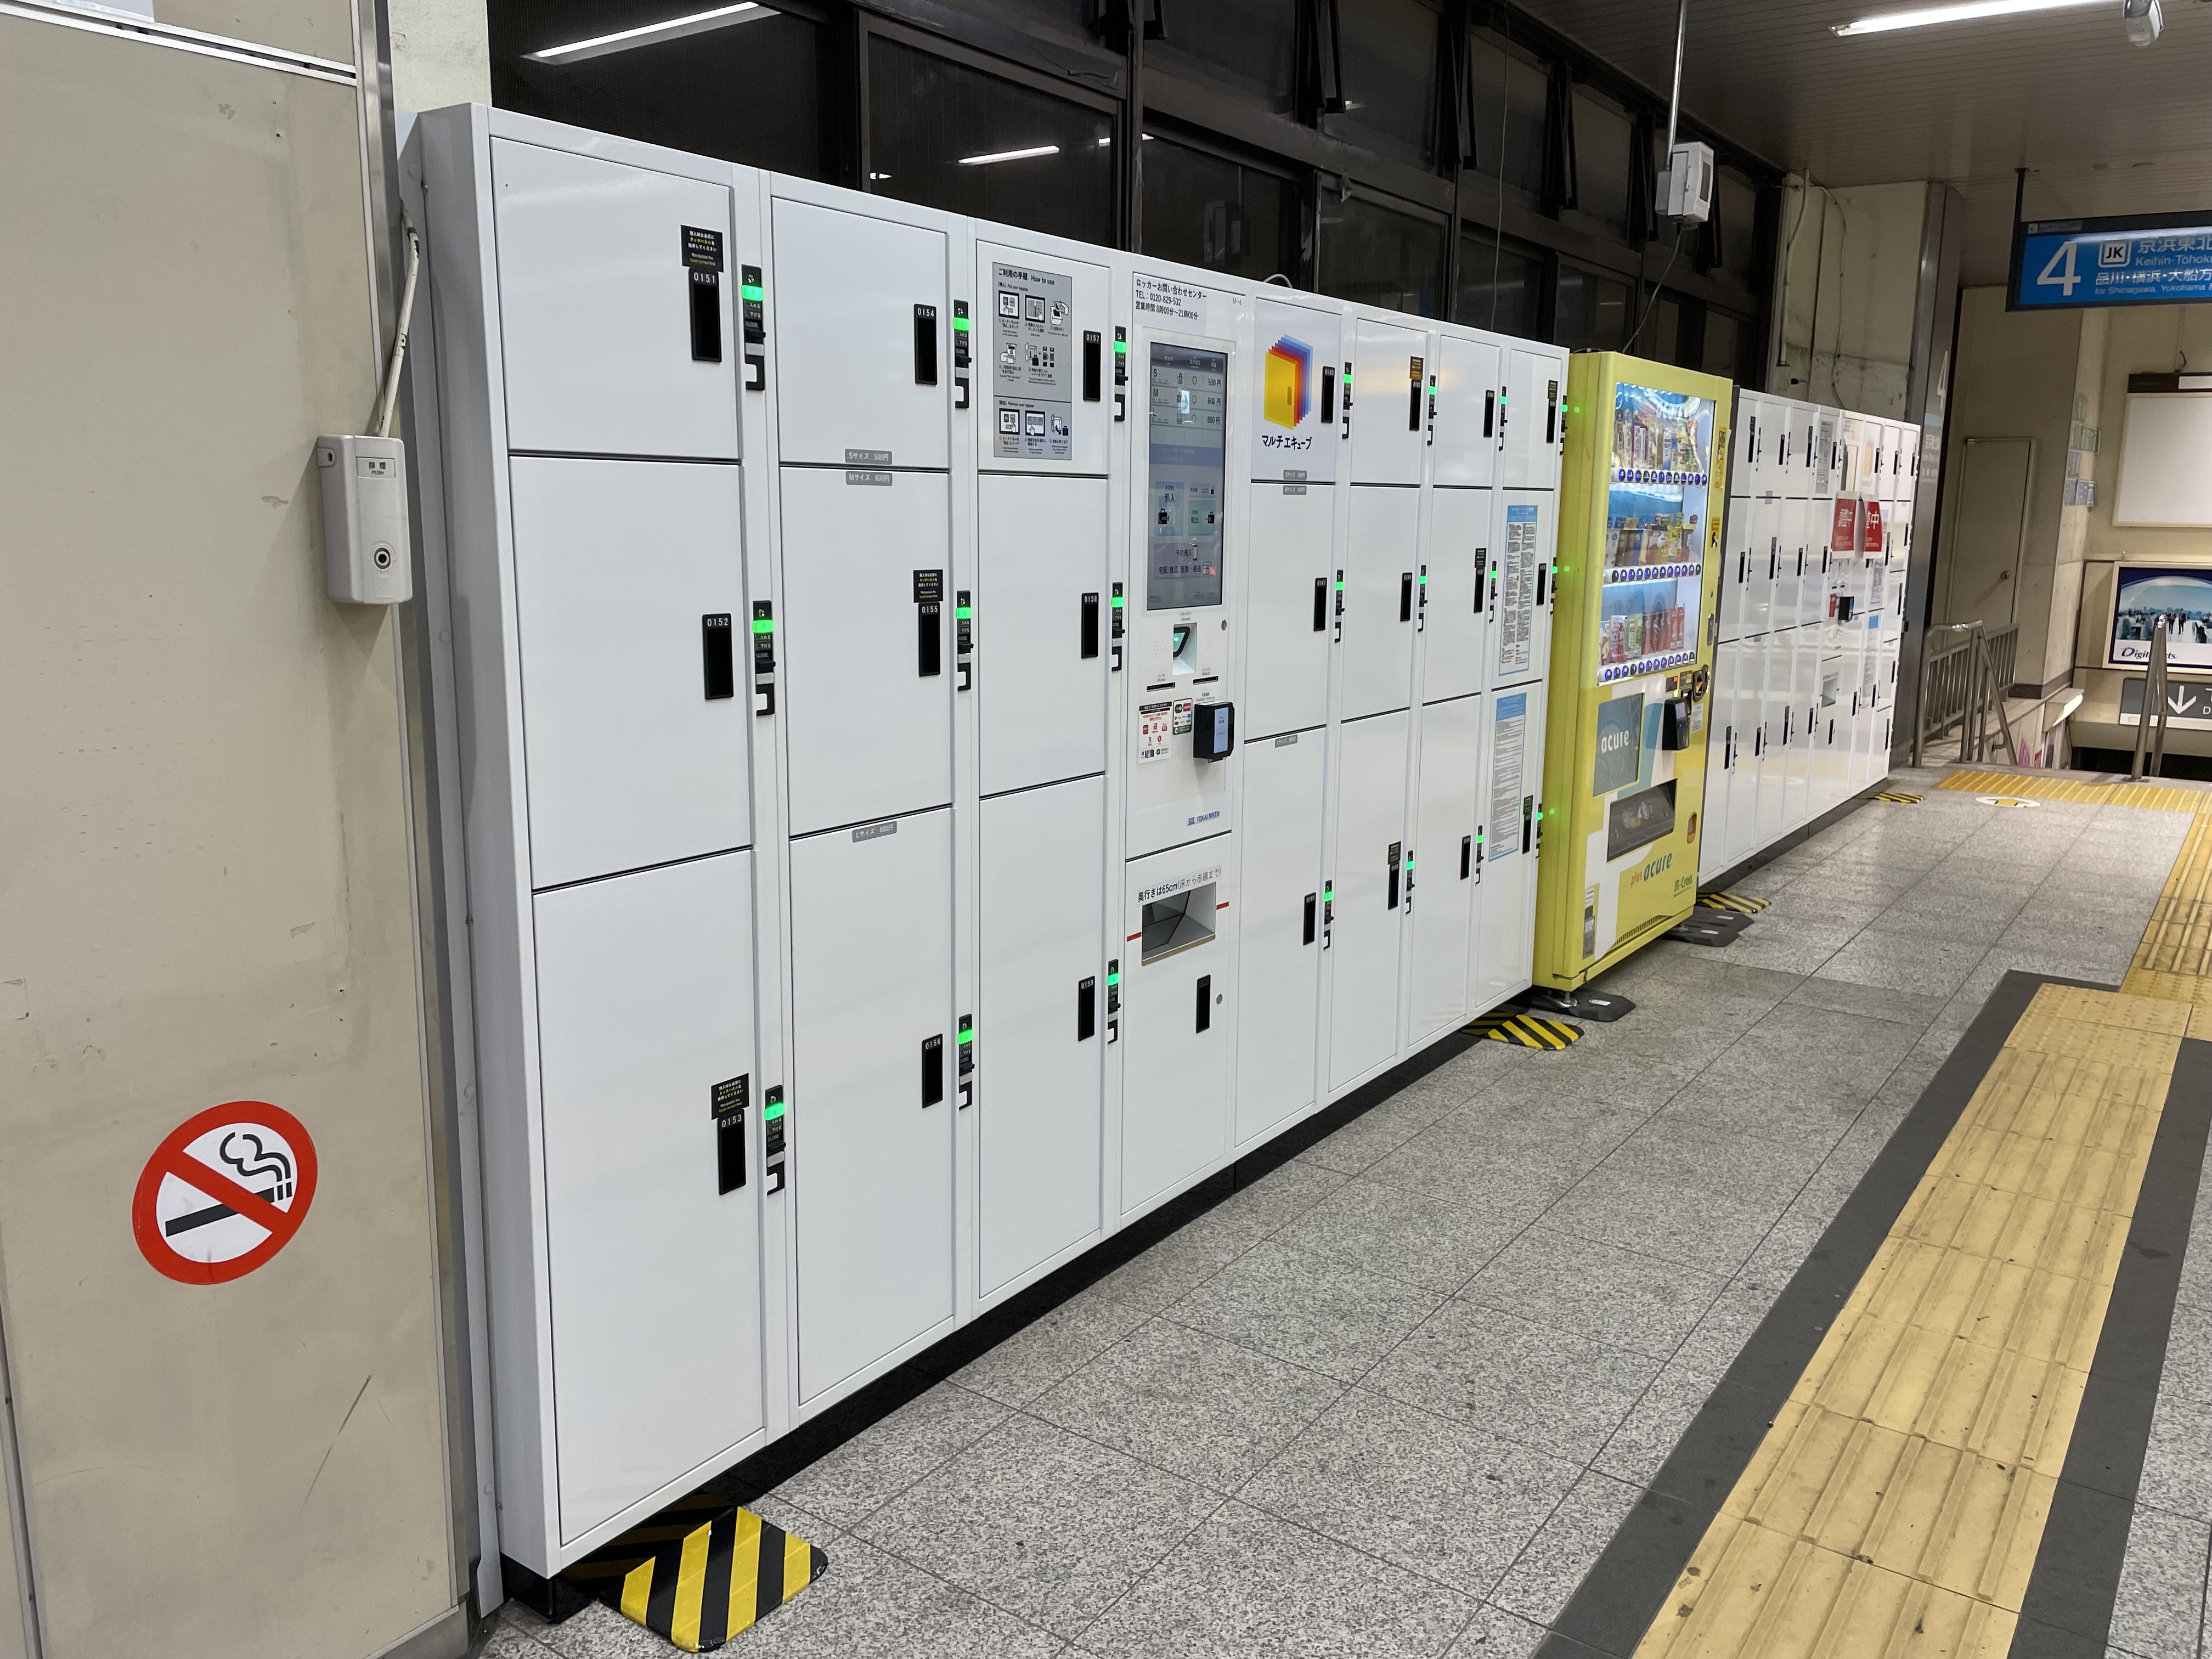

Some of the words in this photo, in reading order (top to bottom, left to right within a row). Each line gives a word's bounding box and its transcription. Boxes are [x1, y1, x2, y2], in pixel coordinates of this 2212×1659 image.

[2106, 246, 2124, 259] JK
[2036, 240, 2081, 296] 4
[693, 272, 715, 284] 0151
[1136, 279, 1207, 299] ロッカーお問い合わせセンター
[917, 308, 934, 317] 0154
[1086, 333, 1099, 342] 0157
[1153, 368, 1157, 377] S
[1153, 388, 1158, 397] M
[849, 452, 869, 460] Sサイズ
[922, 605, 938, 613] 0155
[707, 618, 729, 627] 0152
[1601, 730, 1629, 754] acure
[856, 828, 874, 838] Lサイズ
[1644, 853, 1672, 882] acure
[1081, 979, 1093, 989] 0159
[925, 1038, 941, 1049] 0156
[722, 1114, 742, 1127] 0153
